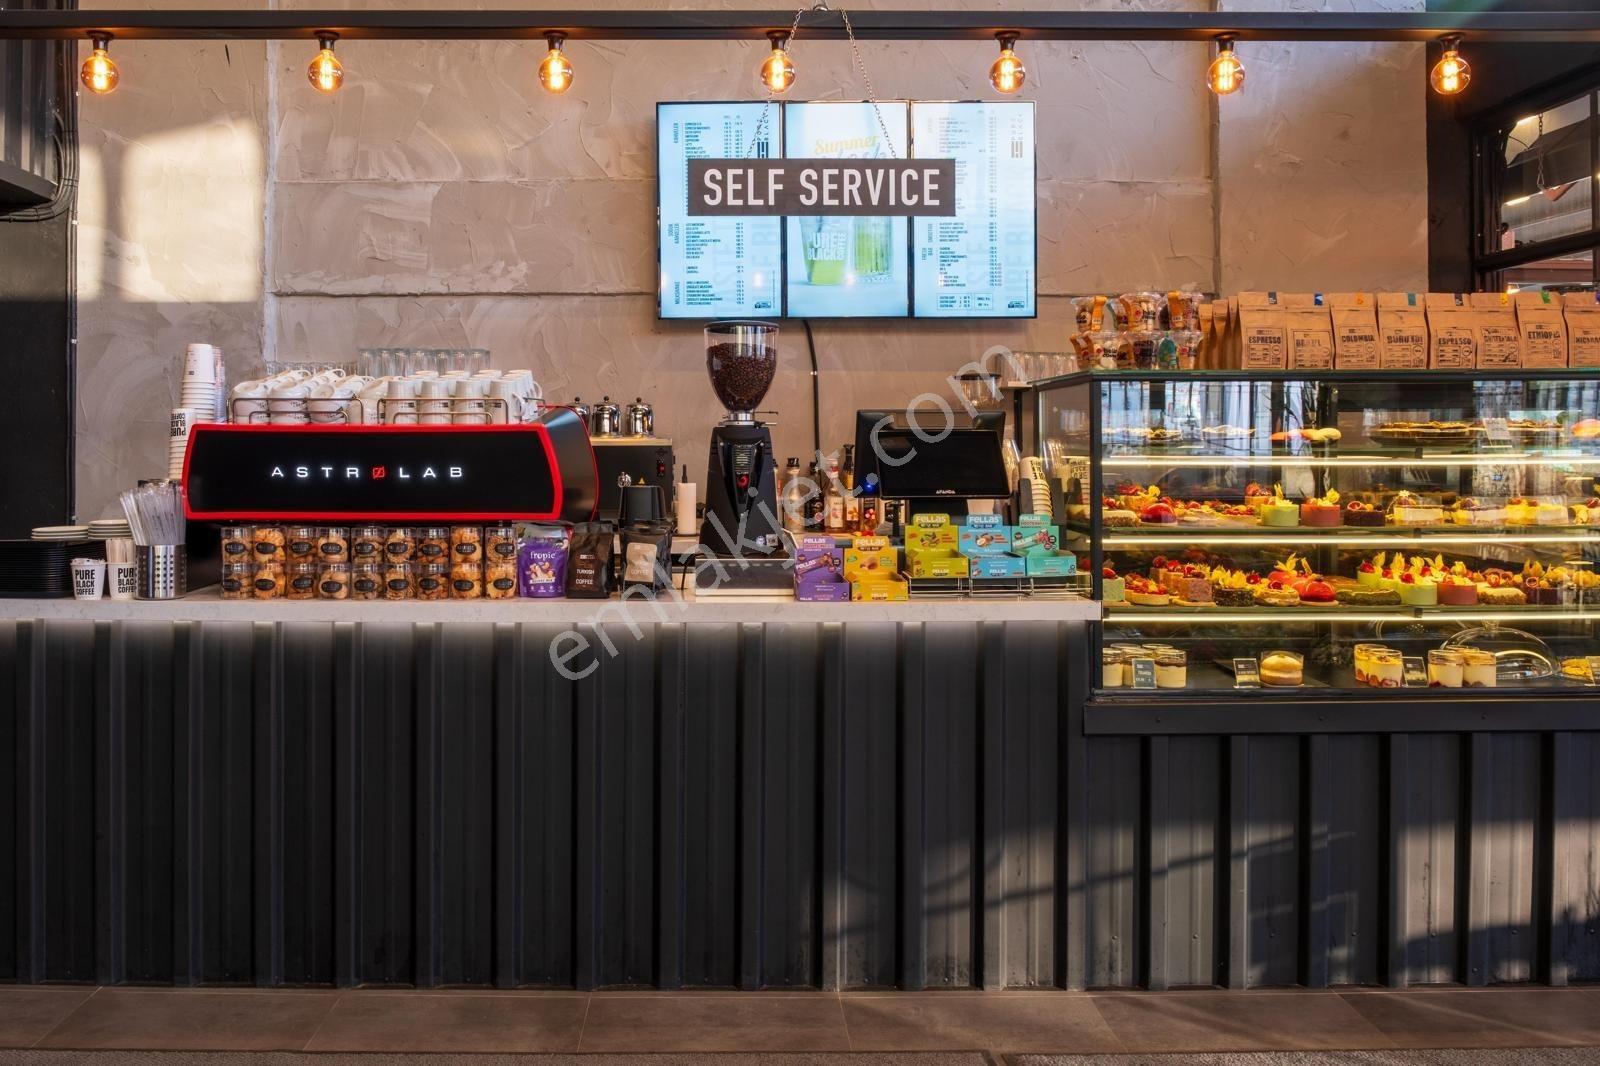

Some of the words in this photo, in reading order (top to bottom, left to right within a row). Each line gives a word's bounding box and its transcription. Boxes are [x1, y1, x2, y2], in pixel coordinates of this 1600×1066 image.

[704, 169, 784, 206] SELF
[800, 169, 939, 206] SERVICE
[1248, 336, 1282, 345] ESPRESSO
[1341, 335, 1375, 343] COLOMBIA
[75, 569, 96, 580] PURE
[117, 567, 134, 578] PUR
[76, 580, 95, 588] BLACK
[117, 578, 134, 586] BLAC
[76, 588, 95, 596] COFFEE
